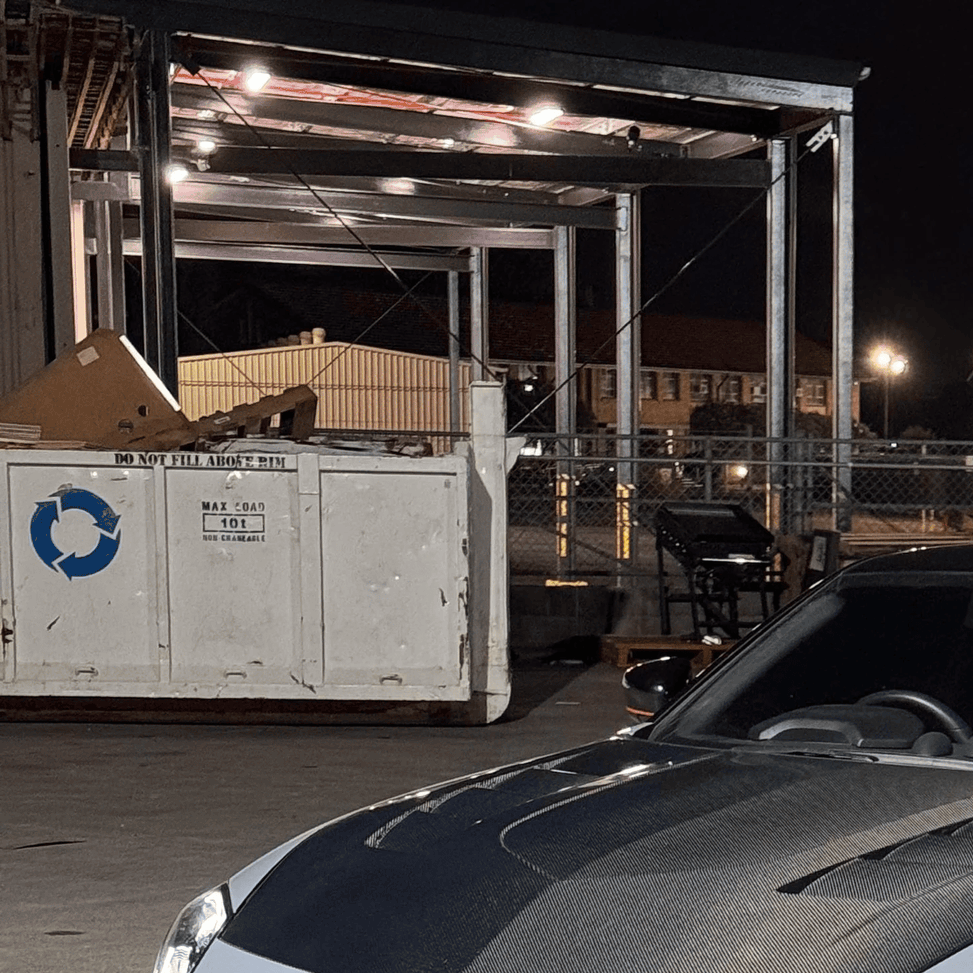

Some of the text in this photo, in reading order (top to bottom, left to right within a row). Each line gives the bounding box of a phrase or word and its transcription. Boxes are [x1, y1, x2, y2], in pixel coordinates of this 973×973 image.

[114, 453, 134, 465] DO
[138, 453, 167, 466] NOT
[172, 454, 203, 466] FILL
[258, 456, 286, 469] RIM
[202, 501, 265, 512] MAX LOAD
[221, 517, 246, 529] 10t
